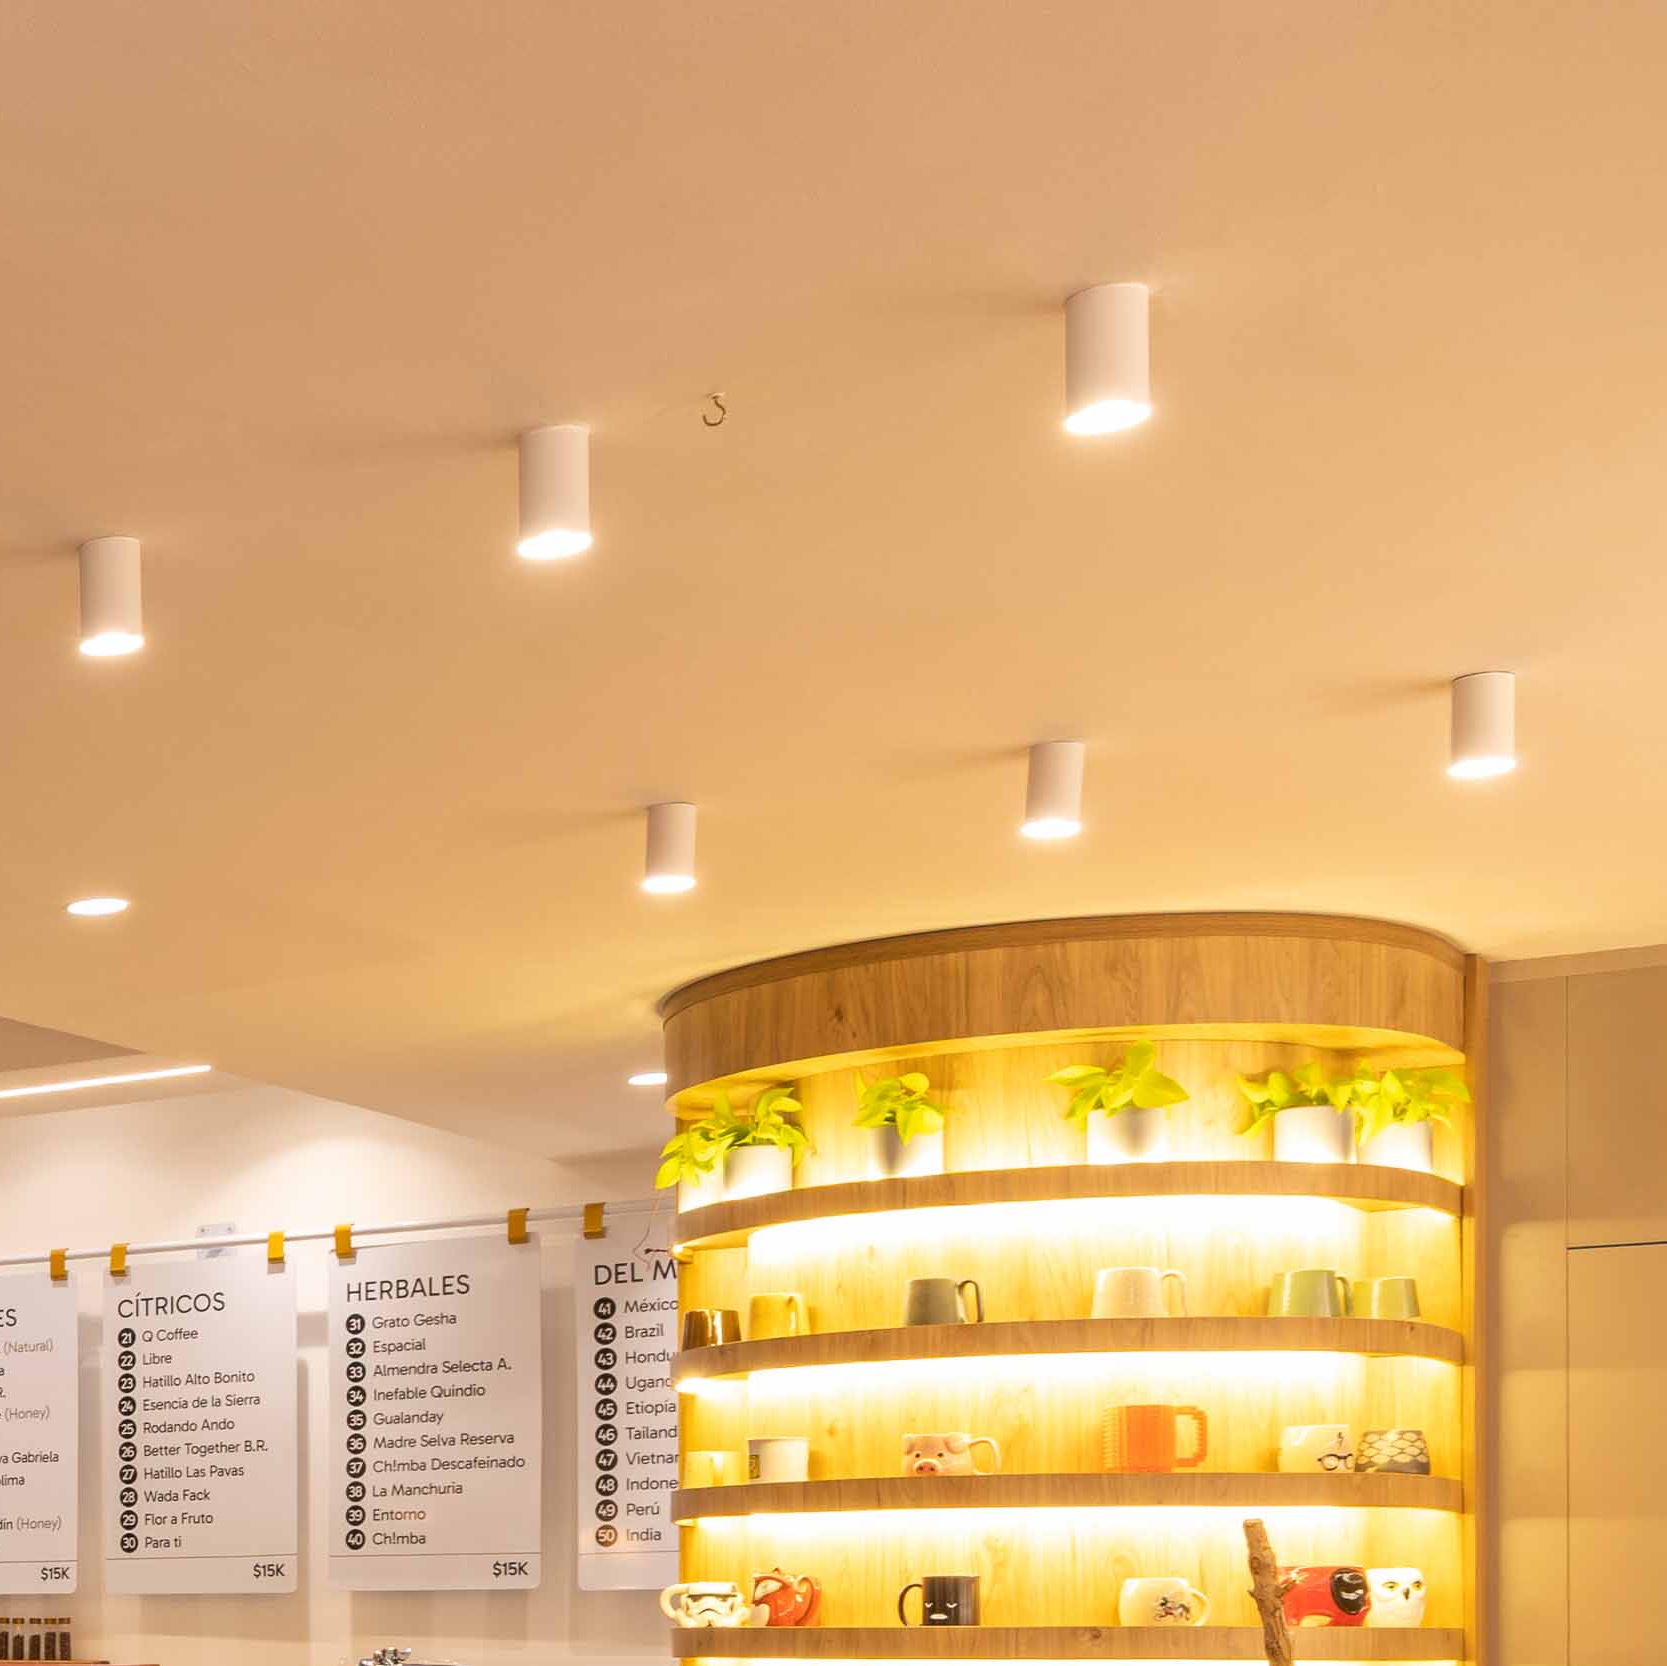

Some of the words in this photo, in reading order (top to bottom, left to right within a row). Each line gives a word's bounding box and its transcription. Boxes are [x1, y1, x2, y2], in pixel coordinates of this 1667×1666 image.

[594, 1262, 644, 1285] DEL
[347, 1274, 471, 1303] HERBALES
[118, 1292, 225, 1318] CÍTRICOS
[372, 1317, 410, 1329] Grato
[414, 1313, 456, 1326] Gesha
[142, 1331, 153, 1343] Q
[157, 1329, 199, 1341] Coffee
[625, 1324, 664, 1338] Brazil
[4, 1338, 53, 1354] (Natural)
[373, 1339, 426, 1355] Espacial
[143, 1353, 172, 1365] Libre
[373, 1363, 438, 1377] Almendra
[442, 1361, 493, 1374] Selecta
[498, 1358, 512, 1371] A.
[143, 1376, 181, 1389] Hatillo
[185, 1374, 210, 1386] Alto
[215, 1371, 255, 1384] Bonito
[374, 1388, 427, 1401] Inefable
[143, 1398, 188, 1411] Esencia
[192, 1397, 207, 1408] de
[211, 1396, 221, 1407] la
[225, 1395, 260, 1407] Sierra
[5, 1406, 50, 1421] (Honey)
[373, 1411, 444, 1426] Gualanday
[143, 1422, 197, 1434] Rodando
[201, 1419, 235, 1431] Ando
[144, 1445, 180, 1457] Better
[185, 1443, 240, 1457] Together
[244, 1440, 268, 1453] B.R.
[374, 1436, 416, 1449] Madre
[420, 1435, 456, 1447] Selva
[460, 1433, 515, 1446] Reserva
[12, 1452, 59, 1463] Gabriela
[373, 1460, 426, 1474] Ch!mba
[431, 1456, 525, 1471] Descafeinado
[144, 1467, 182, 1480] Hatillo
[186, 1466, 206, 1478] Las
[210, 1465, 244, 1477] Pavas
[144, 1491, 179, 1503] Wada
[183, 1489, 210, 1501] Fack
[373, 1485, 387, 1497] La
[392, 1482, 463, 1496] Manchuria
[373, 1509, 426, 1521] Entorno
[627, 1502, 659, 1516] Perú
[17, 1516, 62, 1532] (Honey)
[145, 1514, 167, 1526] Flor
[171, 1516, 177, 1525] a
[182, 1513, 213, 1524] Fruto
[373, 1533, 426, 1545] Ch!mba
[627, 1528, 661, 1541] India
[145, 1537, 171, 1549] Para
[174, 1536, 182, 1547] ti
[41, 1567, 69, 1581] $15K
[253, 1563, 285, 1579] $15K
[493, 1561, 528, 1578] $15K
